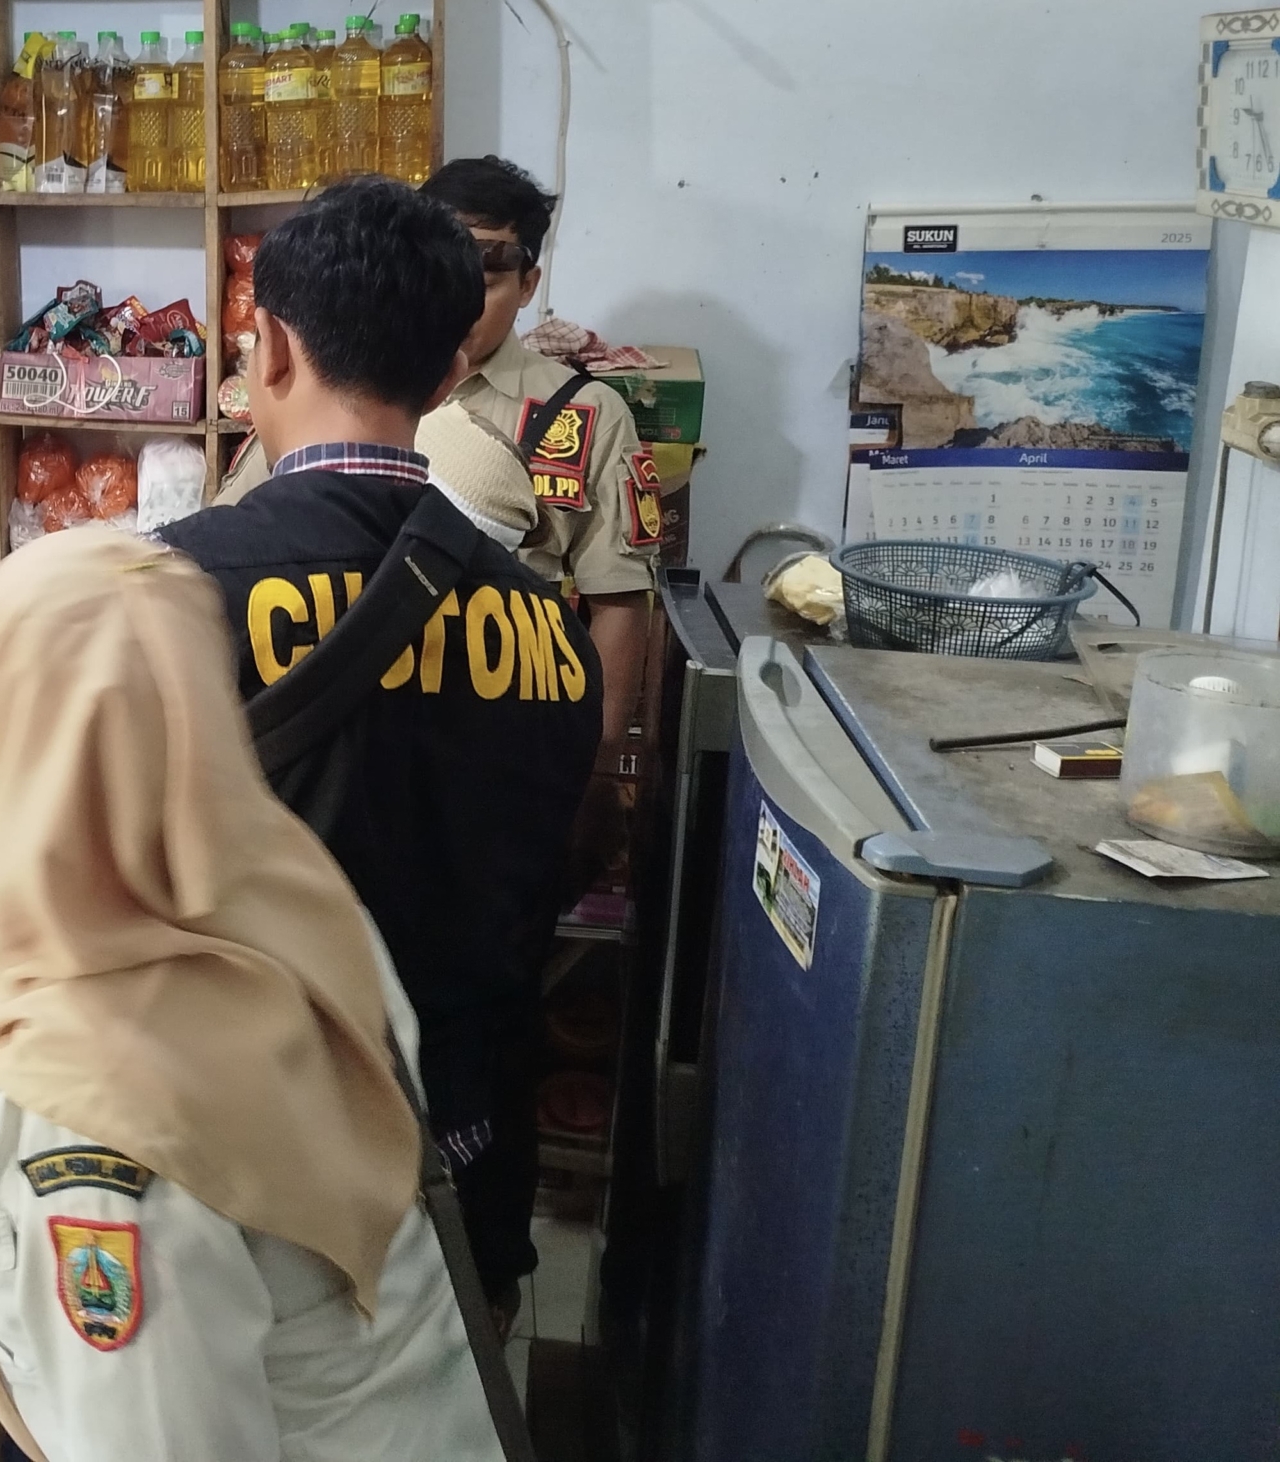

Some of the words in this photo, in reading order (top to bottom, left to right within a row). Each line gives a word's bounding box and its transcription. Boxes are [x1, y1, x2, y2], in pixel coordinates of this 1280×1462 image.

[1246, 61, 1254, 79] 11
[1258, 60, 1269, 78] 12
[1235, 78, 1245, 95] 10
[1234, 108, 1240, 125] 9
[1245, 153, 1252, 171] 7
[907, 230, 954, 243] SUKUN
[1161, 233, 1192, 244] 2025
[6, 365, 59, 383] 50040
[175, 408, 188, 417] 15
[882, 455, 909, 466] Maret
[1019, 453, 1048, 465] April
[556, 476, 579, 498] PP
[990, 494, 996, 503] 1
[1066, 495, 1071, 505] 1
[1086, 496, 1094, 505] 2
[1107, 496, 1115, 506] 3
[1151, 498, 1158, 507] 5
[902, 517, 907, 526] 3
[933, 515, 939, 525] 5
[950, 515, 957, 524] 6
[988, 515, 995, 524] 8
[1043, 516, 1050, 525] 7
[1063, 516, 1071, 526] 8
[1084, 517, 1092, 526] 9
[1103, 518, 1117, 528] 10
[1146, 520, 1160, 529] 12
[984, 536, 996, 545] 15
[1038, 537, 1052, 547] 14
[1058, 538, 1072, 547] 15
[1079, 538, 1093, 548] 16
[1101, 539, 1114, 549] 17
[1143, 541, 1157, 550] 19
[1118, 561, 1133, 571] 25
[1140, 562, 1154, 572] 26
